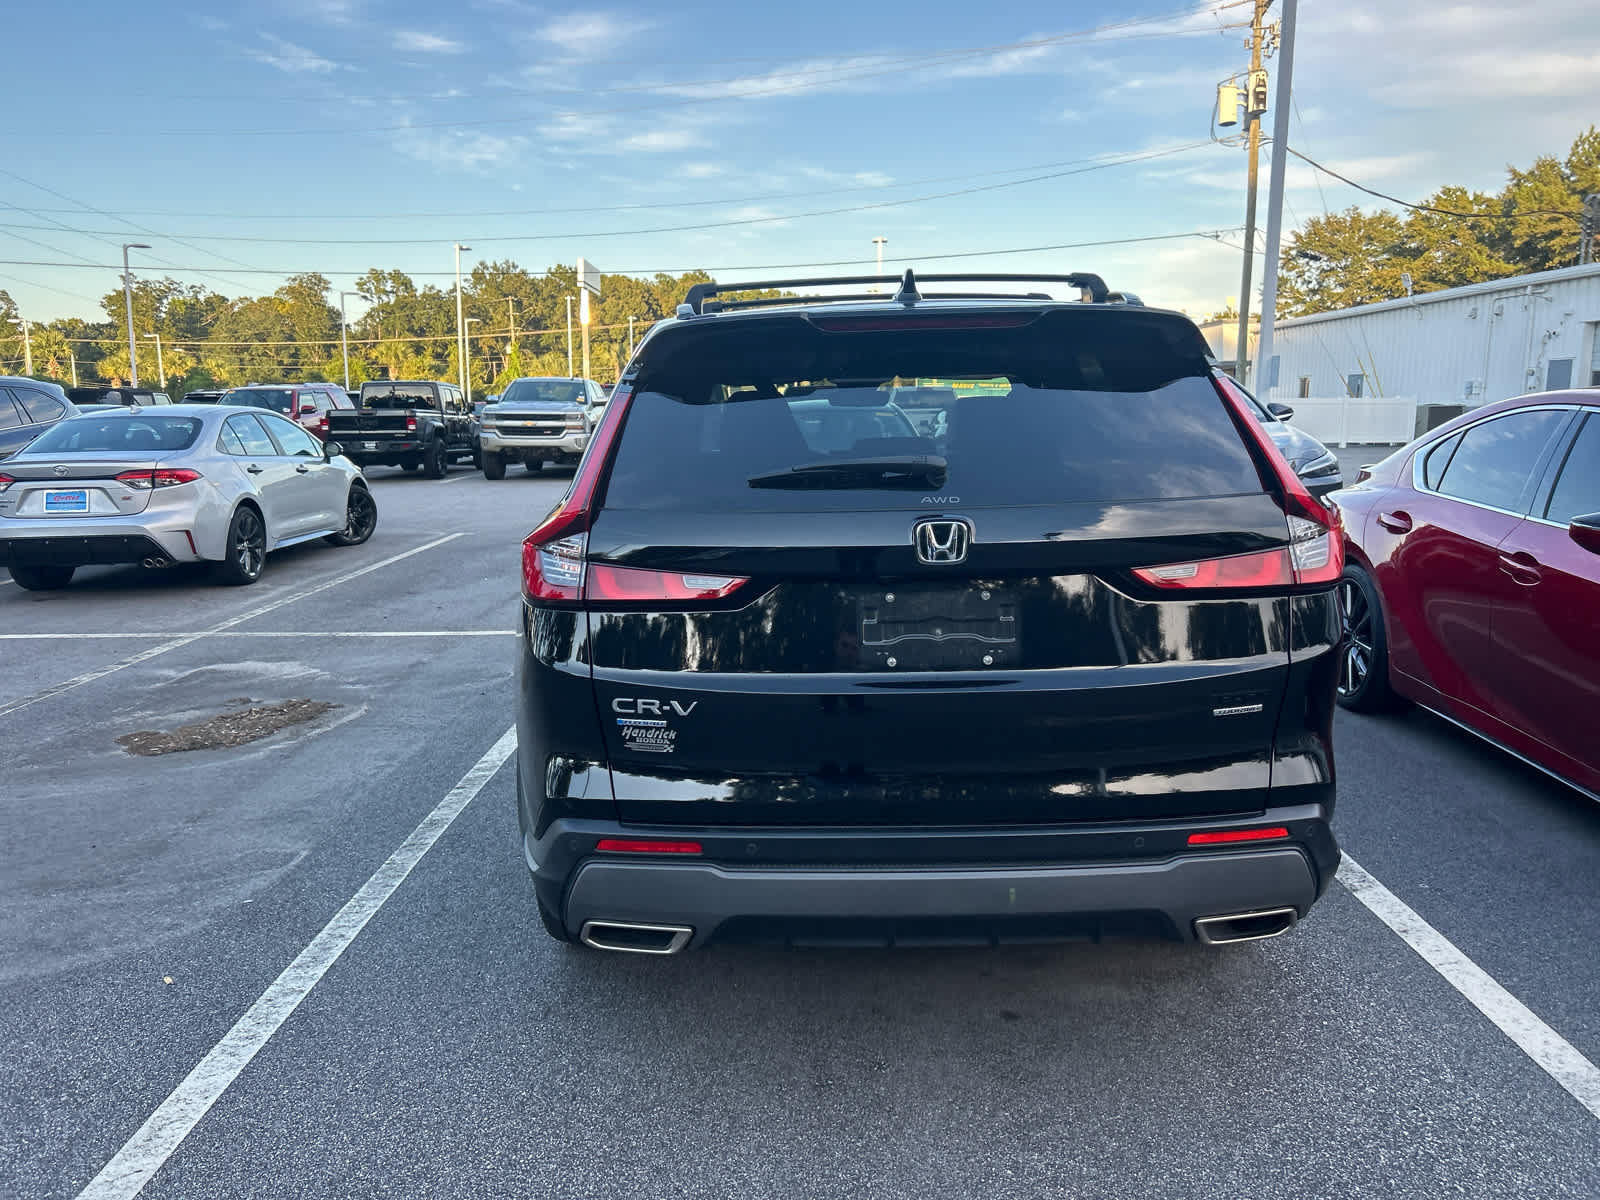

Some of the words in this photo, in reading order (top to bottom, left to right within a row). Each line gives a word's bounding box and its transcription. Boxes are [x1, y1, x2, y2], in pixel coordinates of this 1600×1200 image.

[921, 496, 961, 504] AWD
[611, 697, 698, 716] CR-V
[635, 736, 671, 744] HONDA
